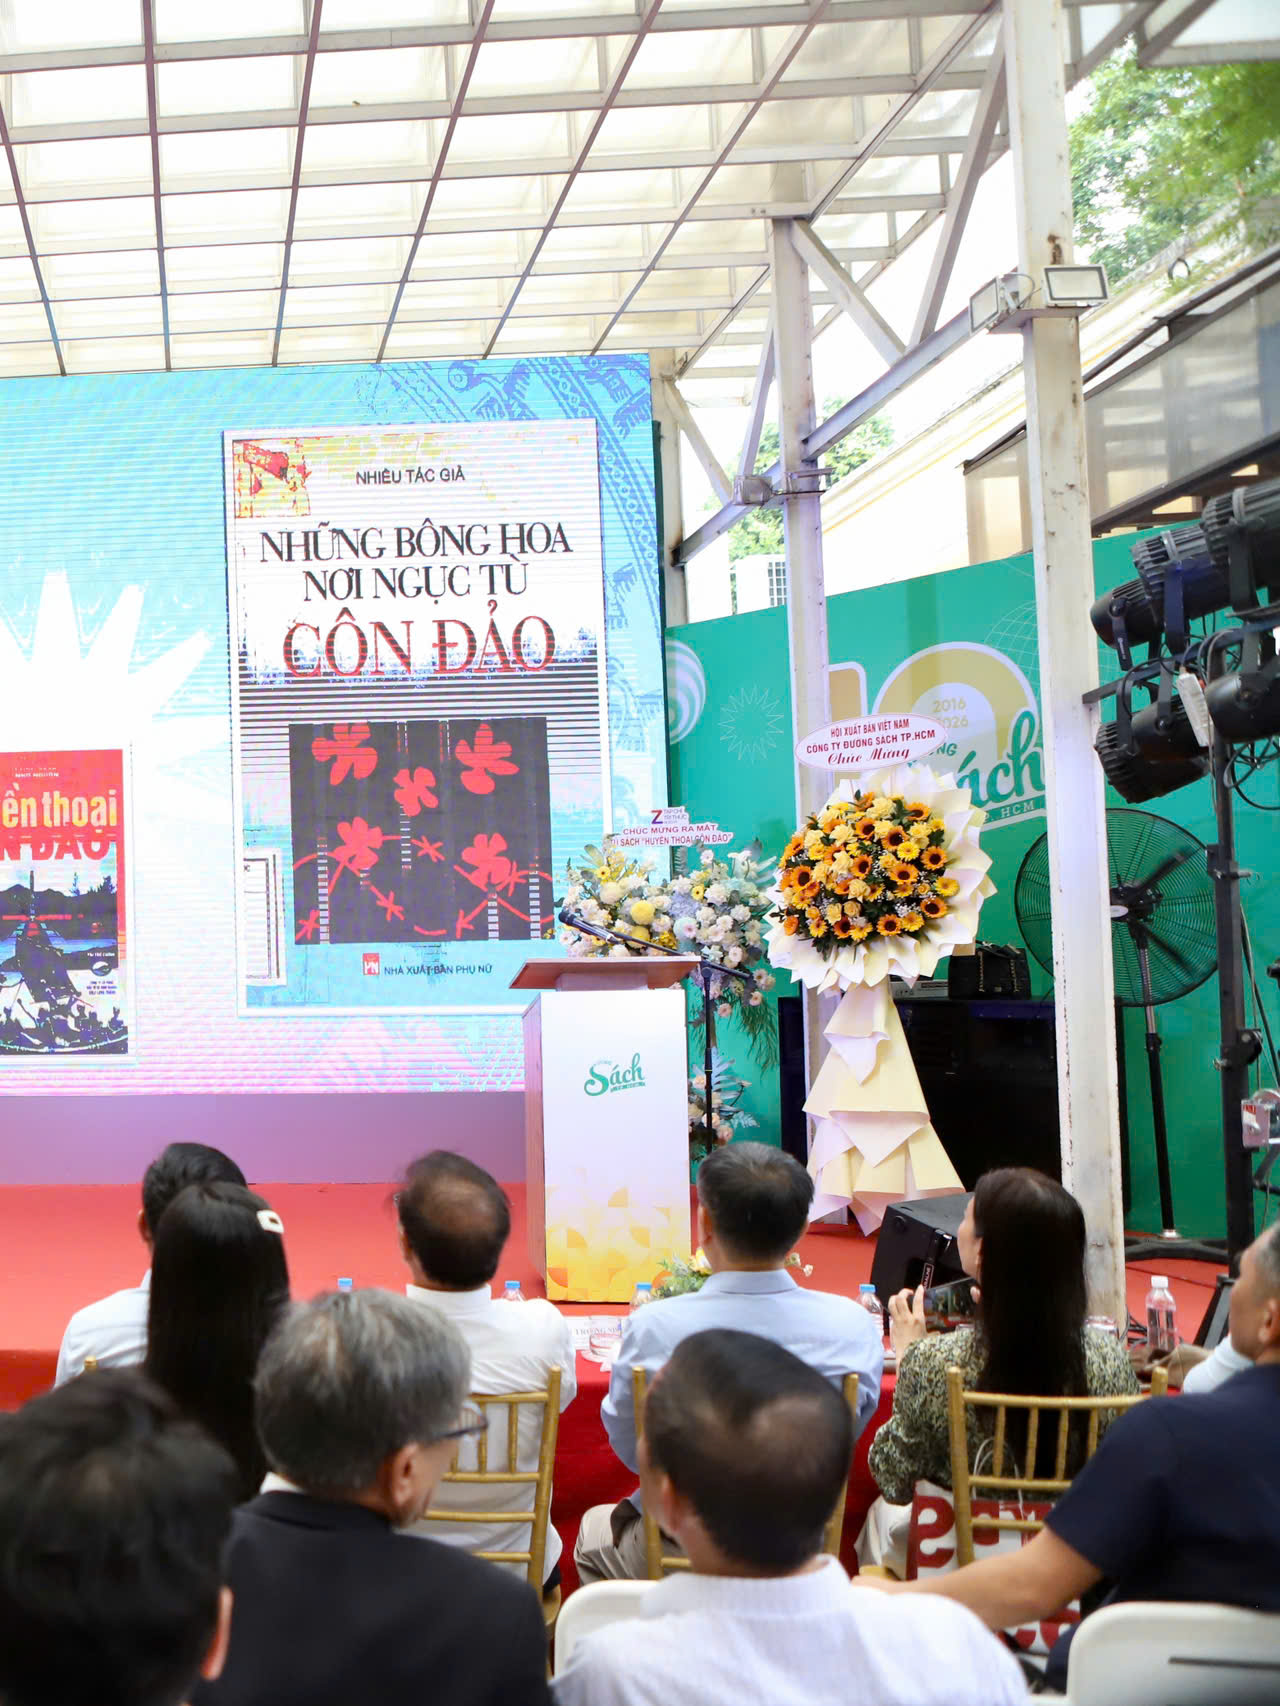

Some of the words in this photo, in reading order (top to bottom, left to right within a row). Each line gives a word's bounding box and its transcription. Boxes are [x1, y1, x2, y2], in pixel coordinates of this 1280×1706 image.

[260, 520, 386, 562] NHỮNG
[394, 517, 491, 558] BÔNG
[499, 521, 573, 554] HOA
[303, 567, 363, 602] NƠI
[373, 565, 471, 605] NGỤC
[479, 553, 528, 596] TÙ
[283, 606, 413, 678] CÔN
[432, 600, 556, 673] ĐẢO
[933, 698, 966, 712] 2016
[893, 718, 910, 729] NAM
[938, 715, 969, 728] 026
[831, 742, 841, 750] TY
[876, 733, 898, 745] SÁCH
[900, 729, 936, 742] TP.HCM
[827, 751, 863, 765] Chúc
[956, 710, 1046, 809] ách
[42, 789, 117, 833] thoại
[651, 809, 664, 824] Z
[623, 827, 648, 836] CHÚC
[584, 1052, 646, 1097] Sách
